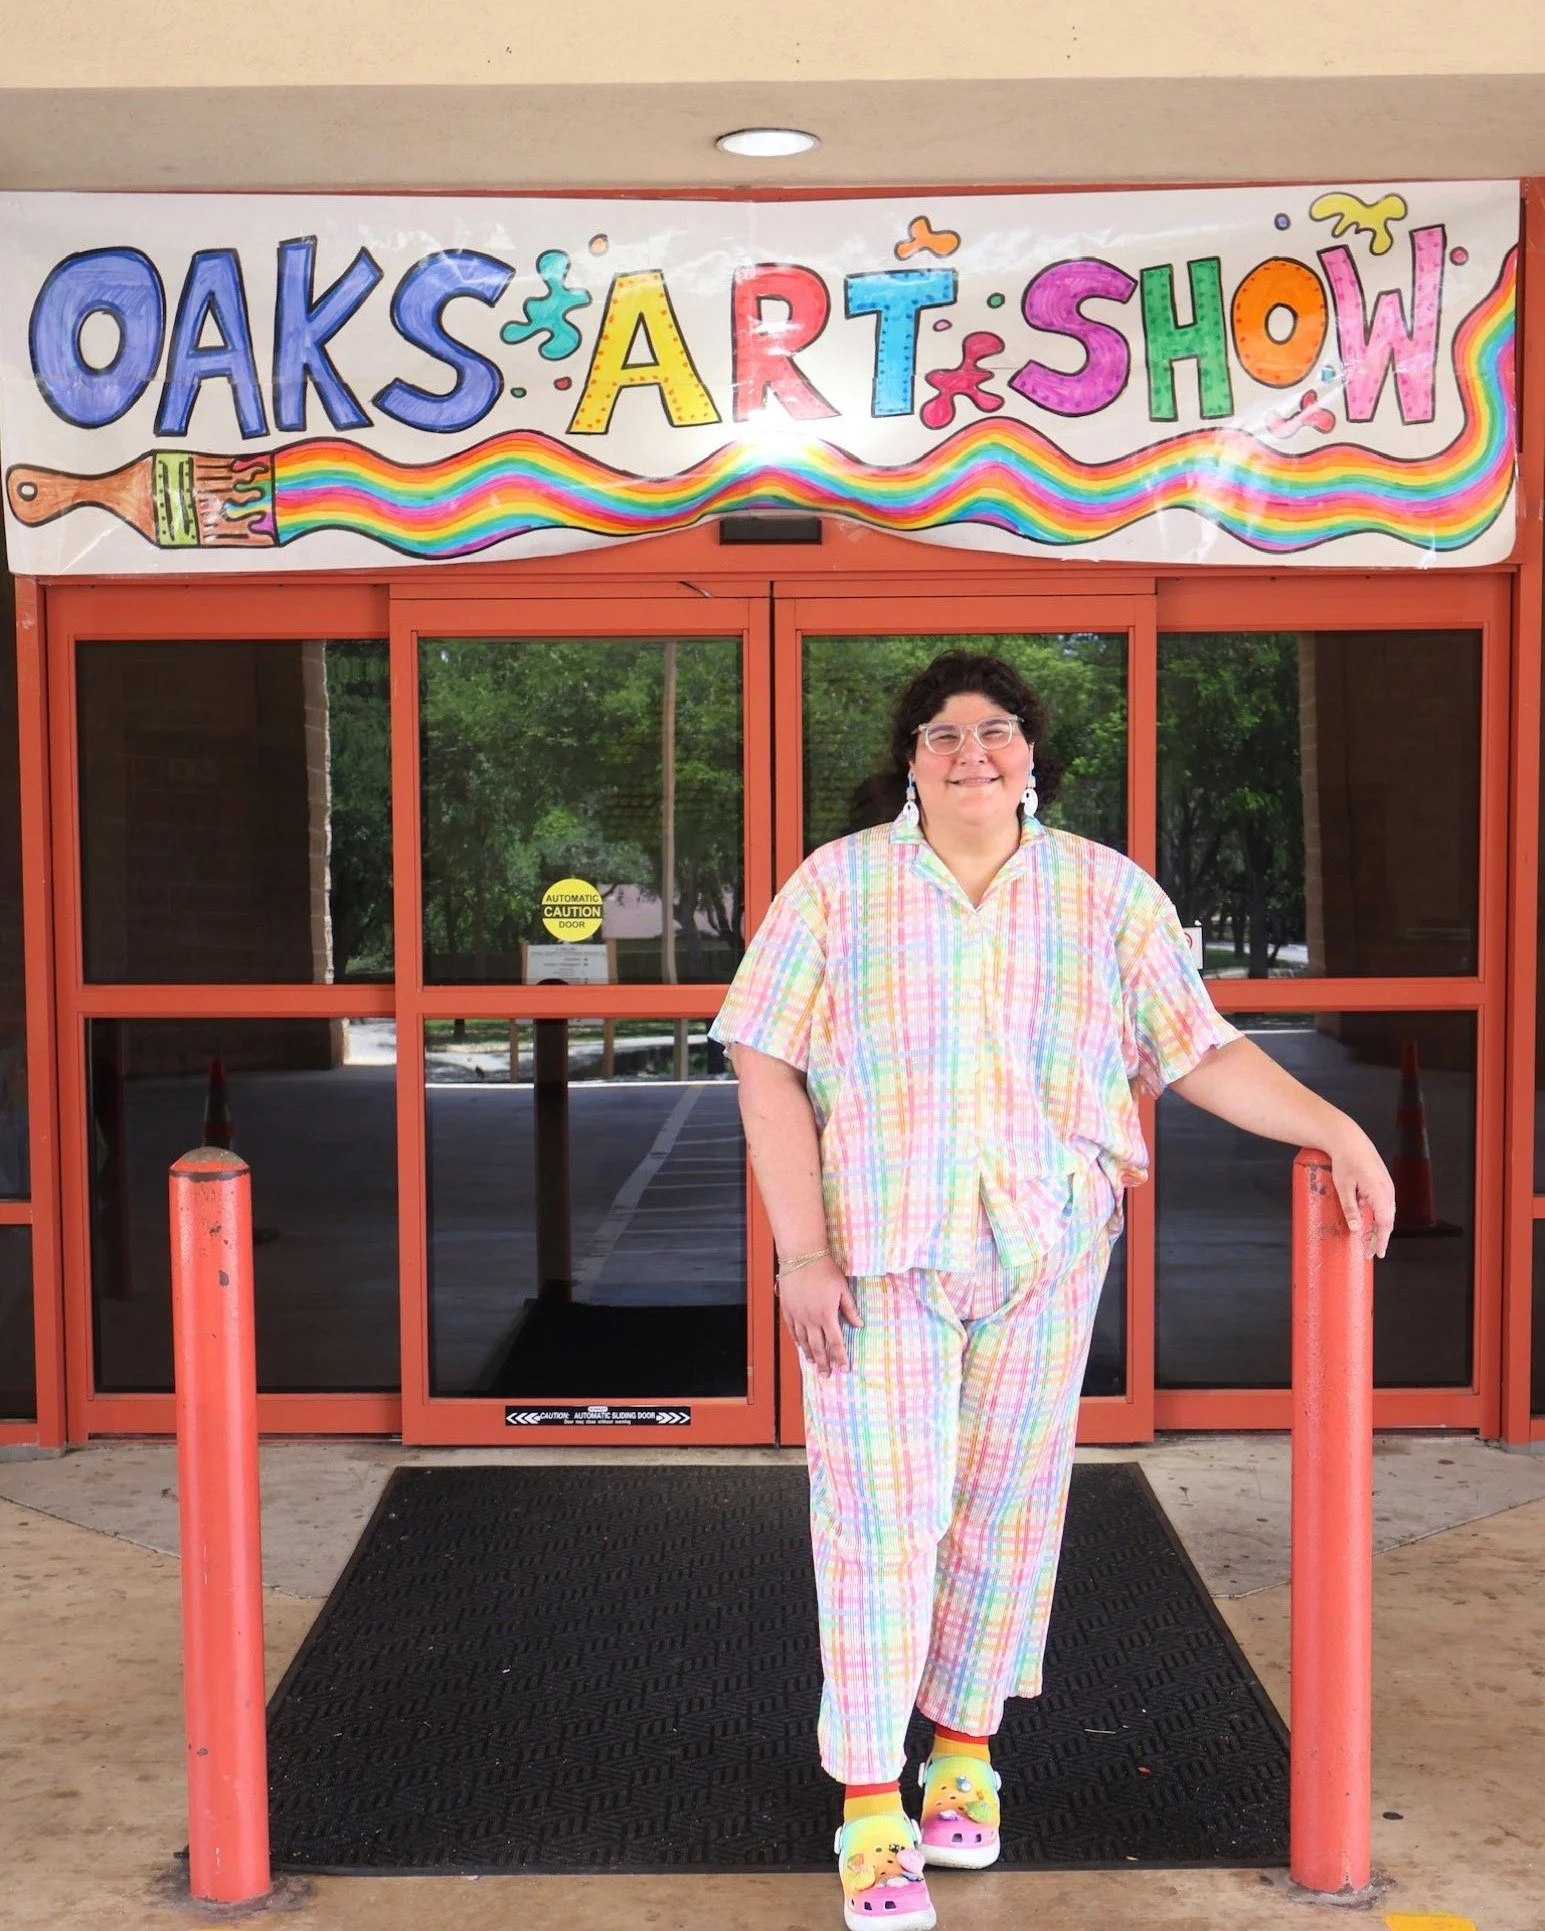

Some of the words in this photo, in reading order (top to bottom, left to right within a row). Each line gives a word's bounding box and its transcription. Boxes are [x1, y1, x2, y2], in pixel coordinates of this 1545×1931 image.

[29, 235, 516, 438] OAKS
[566, 262, 957, 435] ART
[1008, 225, 1445, 423] SHOW
[546, 894, 599, 903] AUTOMATIC
[543, 906, 601, 917] CAUTION
[637, 1411, 655, 1419] DOOR
